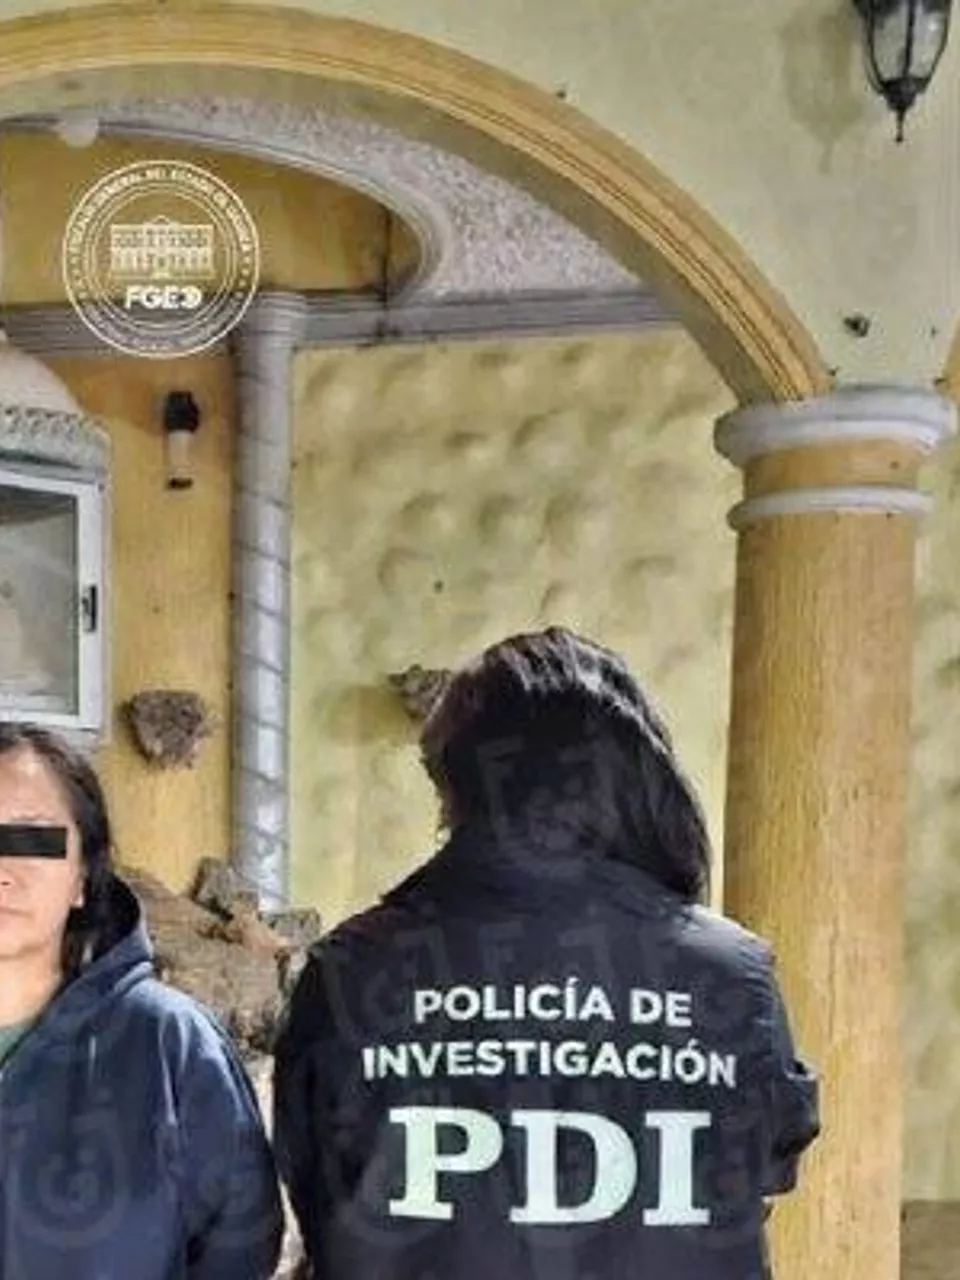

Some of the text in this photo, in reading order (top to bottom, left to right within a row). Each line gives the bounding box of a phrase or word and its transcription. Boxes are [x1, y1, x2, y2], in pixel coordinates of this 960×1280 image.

[414, 977, 693, 1027] POLICÍA DE
[362, 1039, 737, 1088] INVESTIGACIÓN
[388, 1105, 712, 1227] PDI
